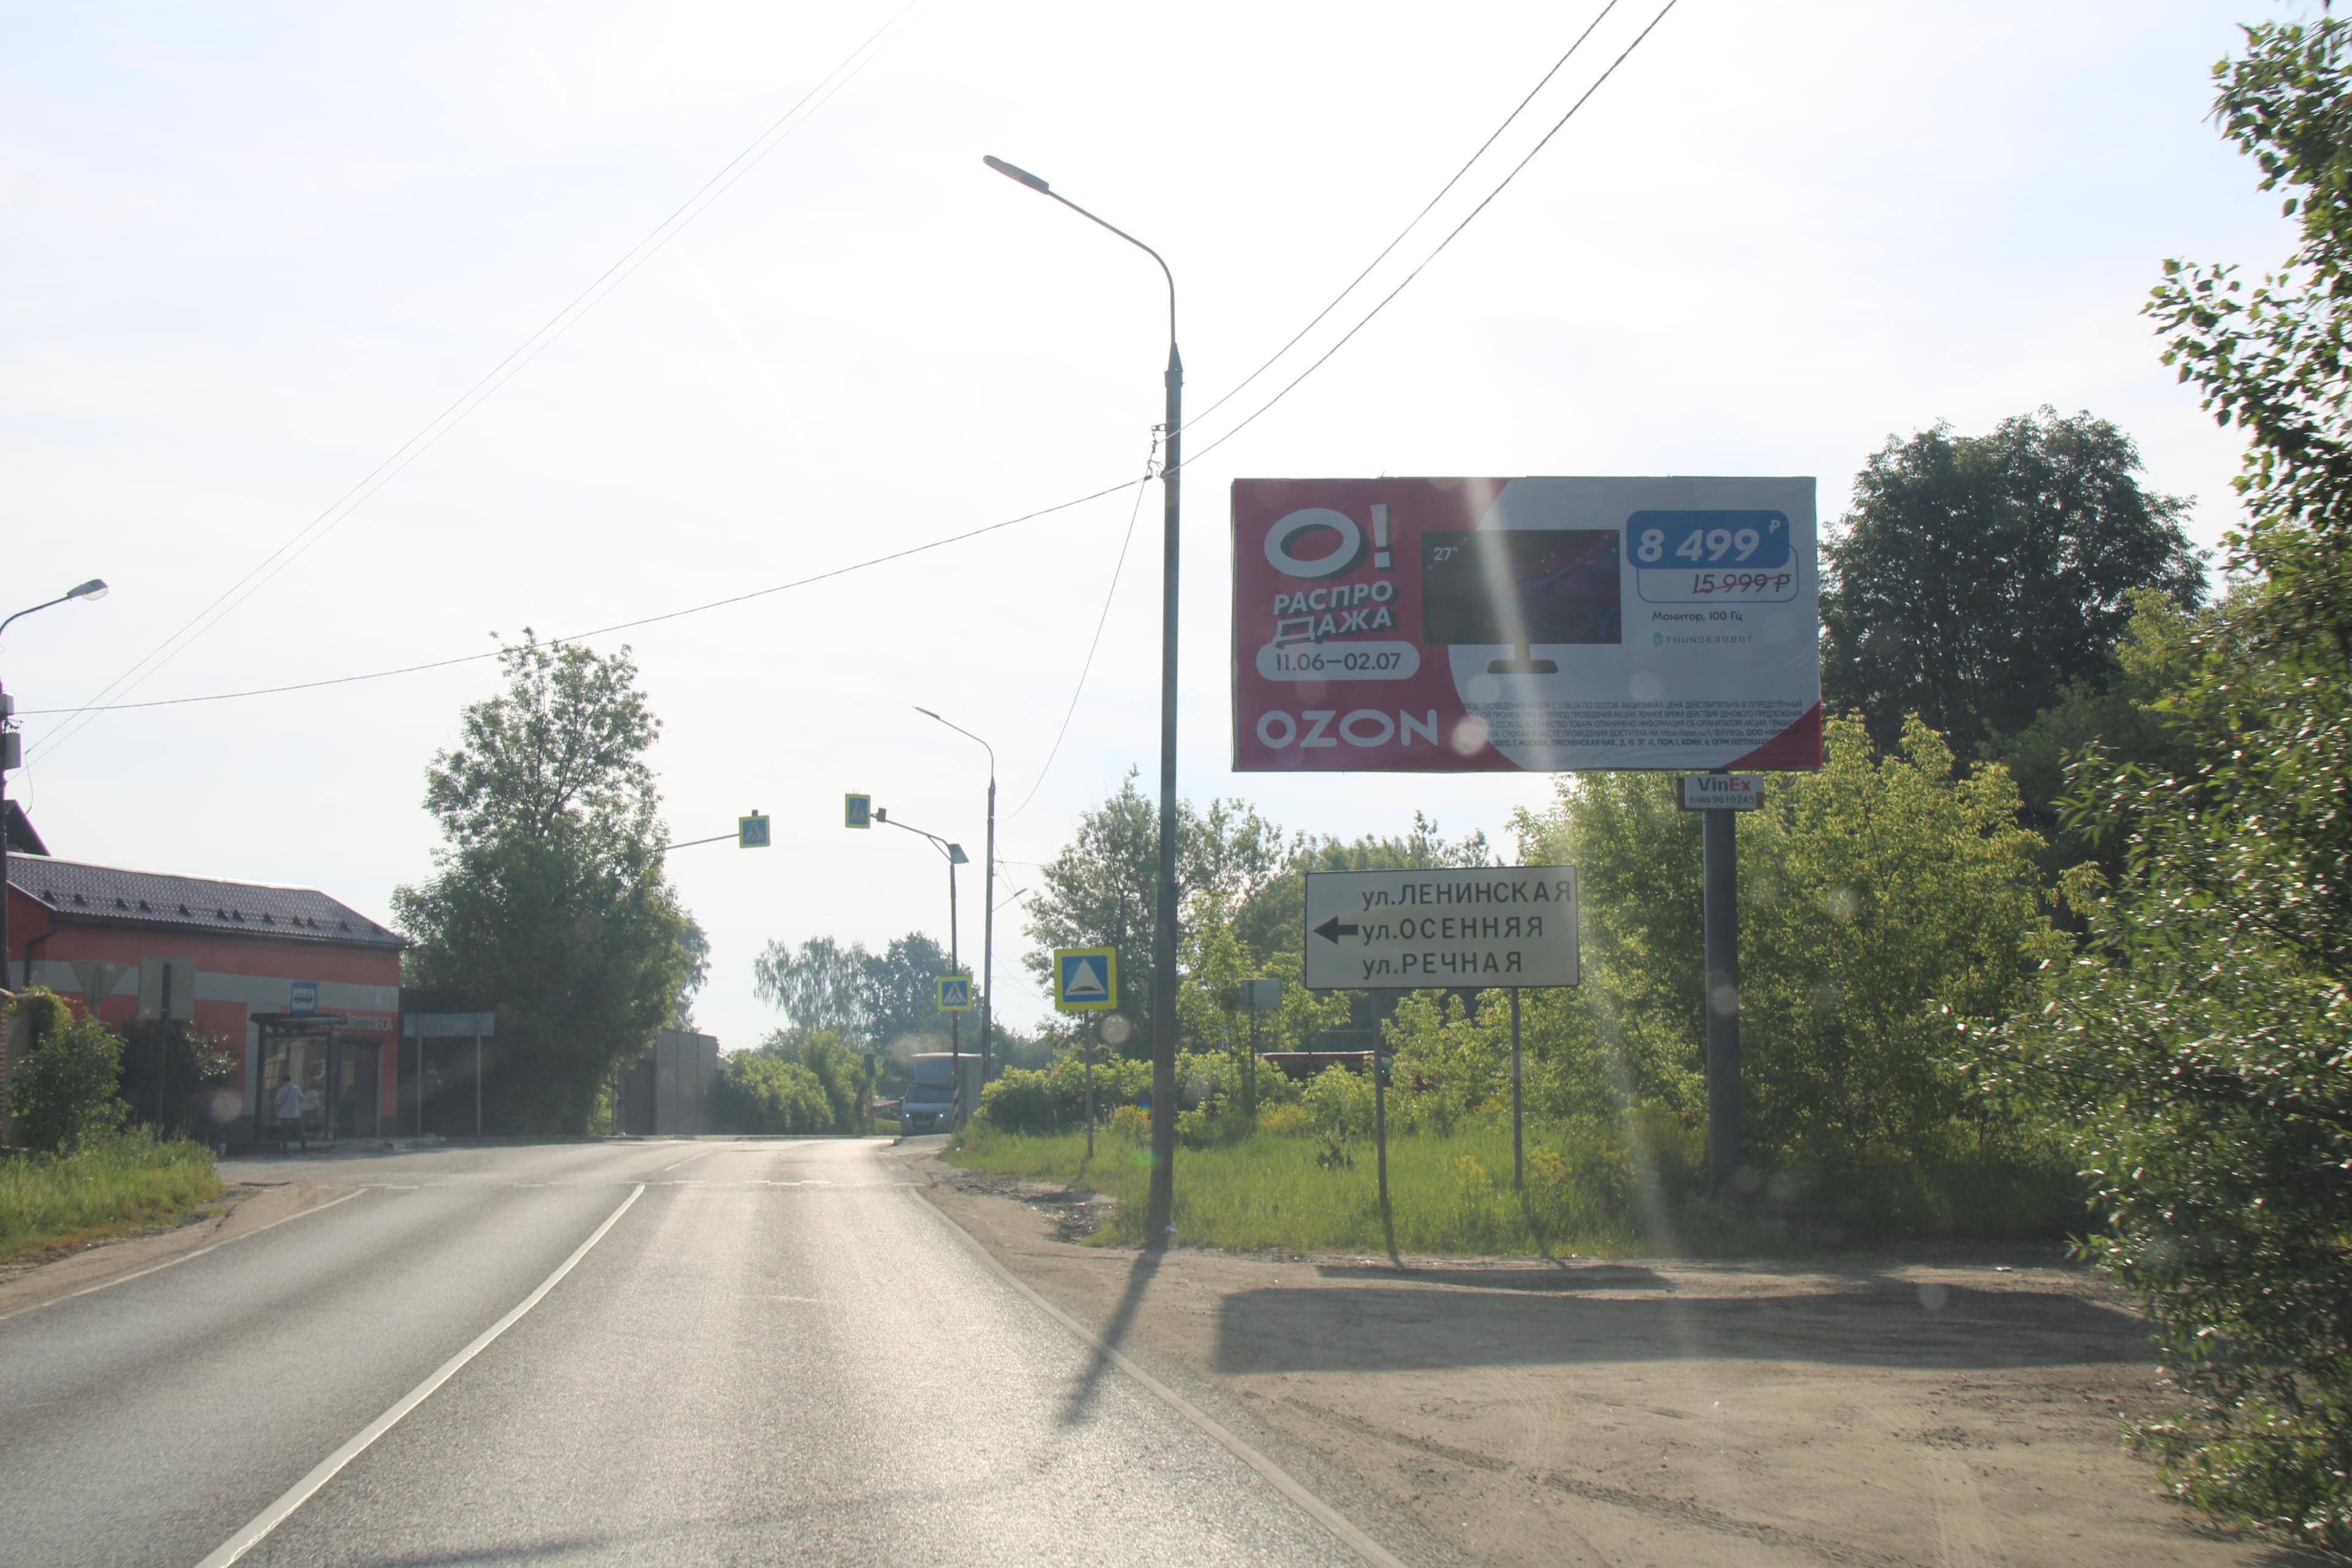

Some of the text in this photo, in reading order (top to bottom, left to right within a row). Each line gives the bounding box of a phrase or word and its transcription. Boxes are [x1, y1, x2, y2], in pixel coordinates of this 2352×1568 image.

[1637, 528, 1665, 563] 8
[1675, 528, 1760, 562] 499
[1273, 580, 1393, 616] РАСПРО
[1693, 573, 1715, 593] 15
[1722, 573, 1768, 593] 999
[1272, 606, 1392, 644] ДАЖА
[1652, 611, 1743, 623] Монитор, 100 Гц
[1256, 709, 1439, 749] OZON
[1697, 777, 1752, 792] VinEx
